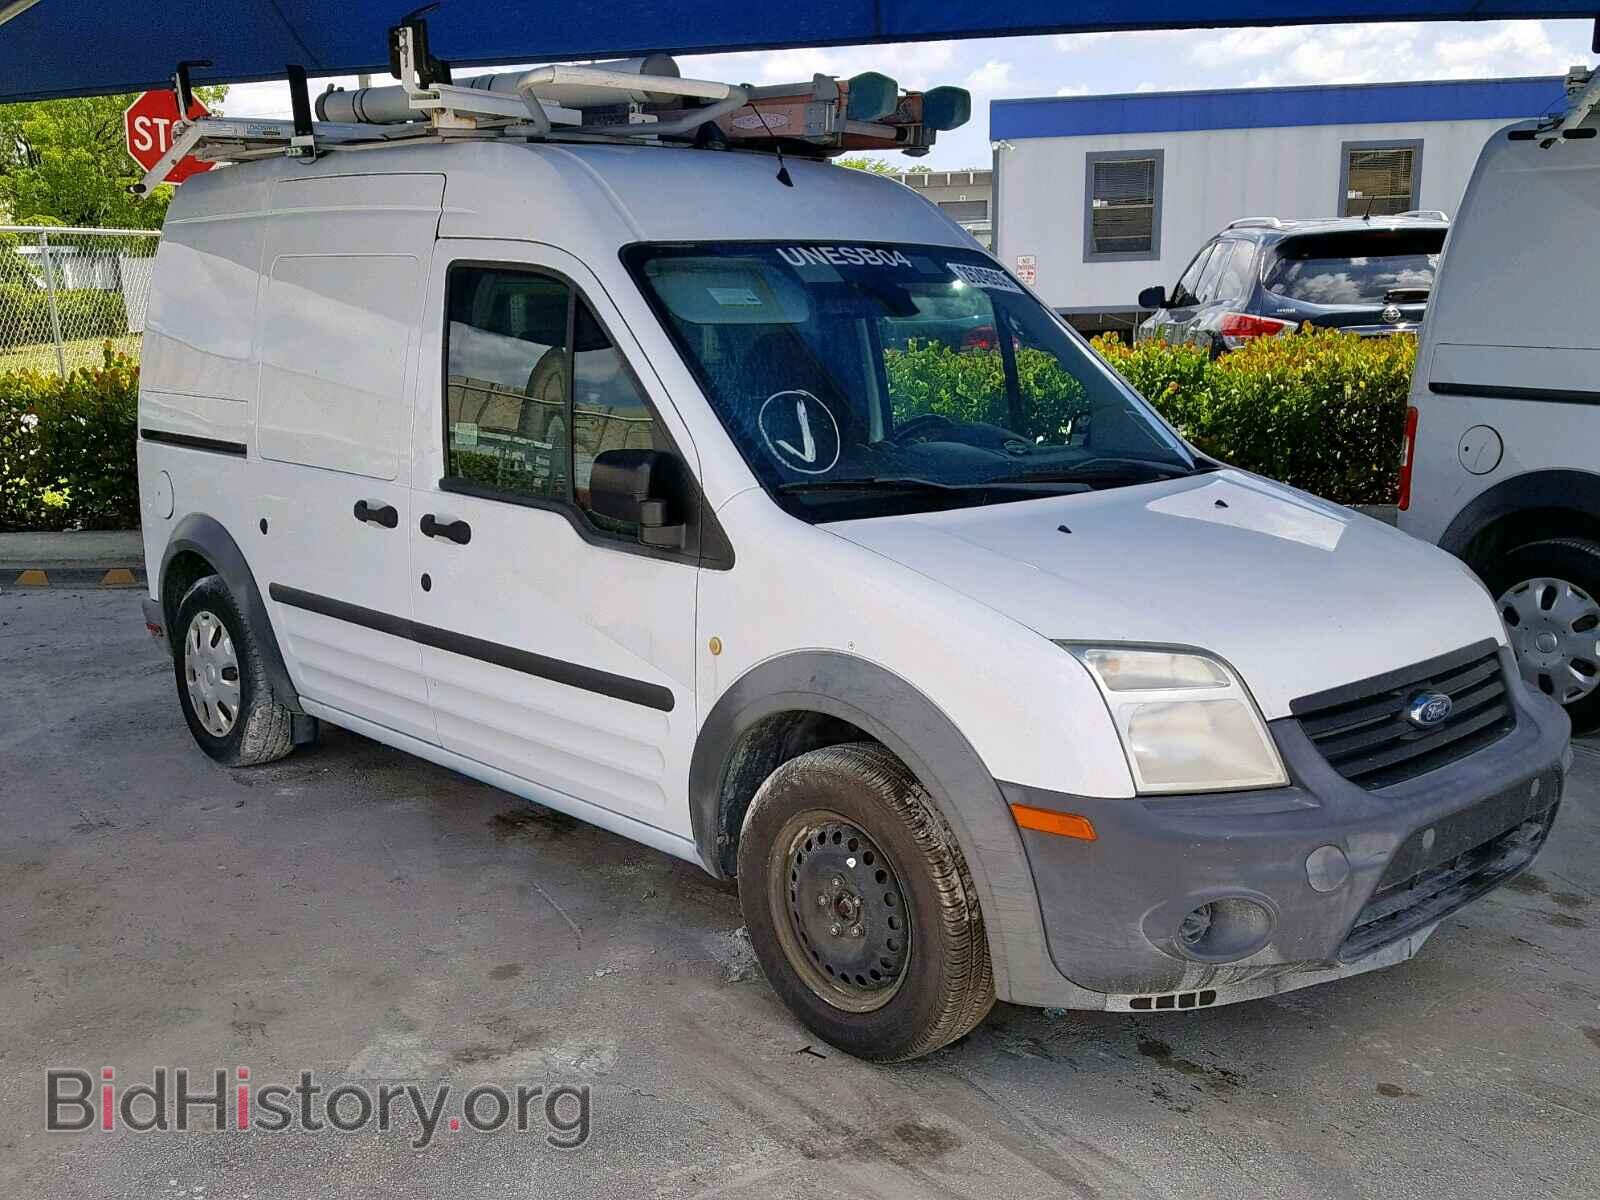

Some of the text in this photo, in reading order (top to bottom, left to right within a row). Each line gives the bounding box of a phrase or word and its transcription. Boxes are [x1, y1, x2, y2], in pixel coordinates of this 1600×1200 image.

[134, 115, 184, 153] ST
[776, 246, 913, 267] UNESB04
[1426, 701, 1448, 721] Ford
